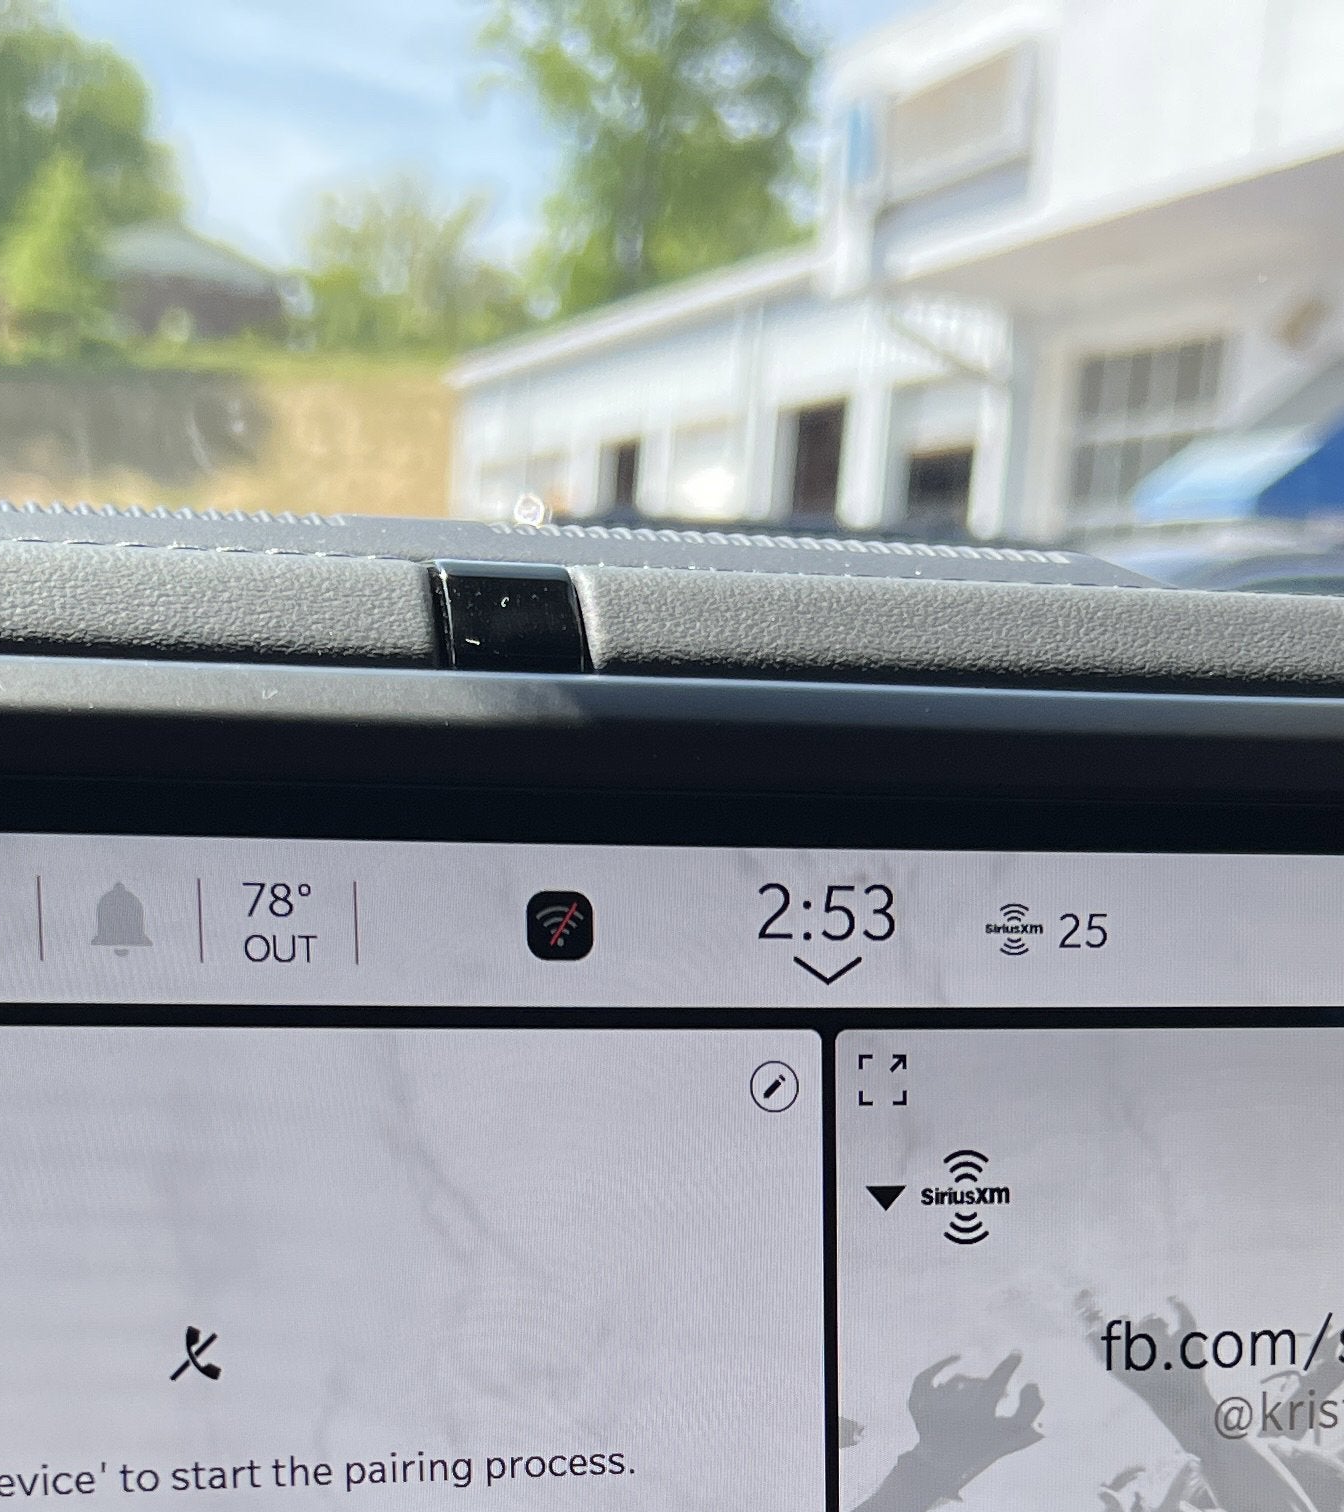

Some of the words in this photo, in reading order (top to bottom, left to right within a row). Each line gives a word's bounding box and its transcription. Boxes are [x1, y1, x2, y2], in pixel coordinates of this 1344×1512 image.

[242, 882, 312, 918] 78°
[758, 882, 896, 942] 2:53
[244, 934, 318, 963] OUT
[985, 919, 1044, 935] SiriusXM
[1058, 912, 1108, 949] 25
[920, 1184, 1011, 1206] SiriusXM
[119, 1464, 160, 1493] to
[171, 1459, 262, 1491] start
[271, 1455, 333, 1487] the
[346, 1450, 472, 1493] pairing
[486, 1452, 635, 1487] process.
